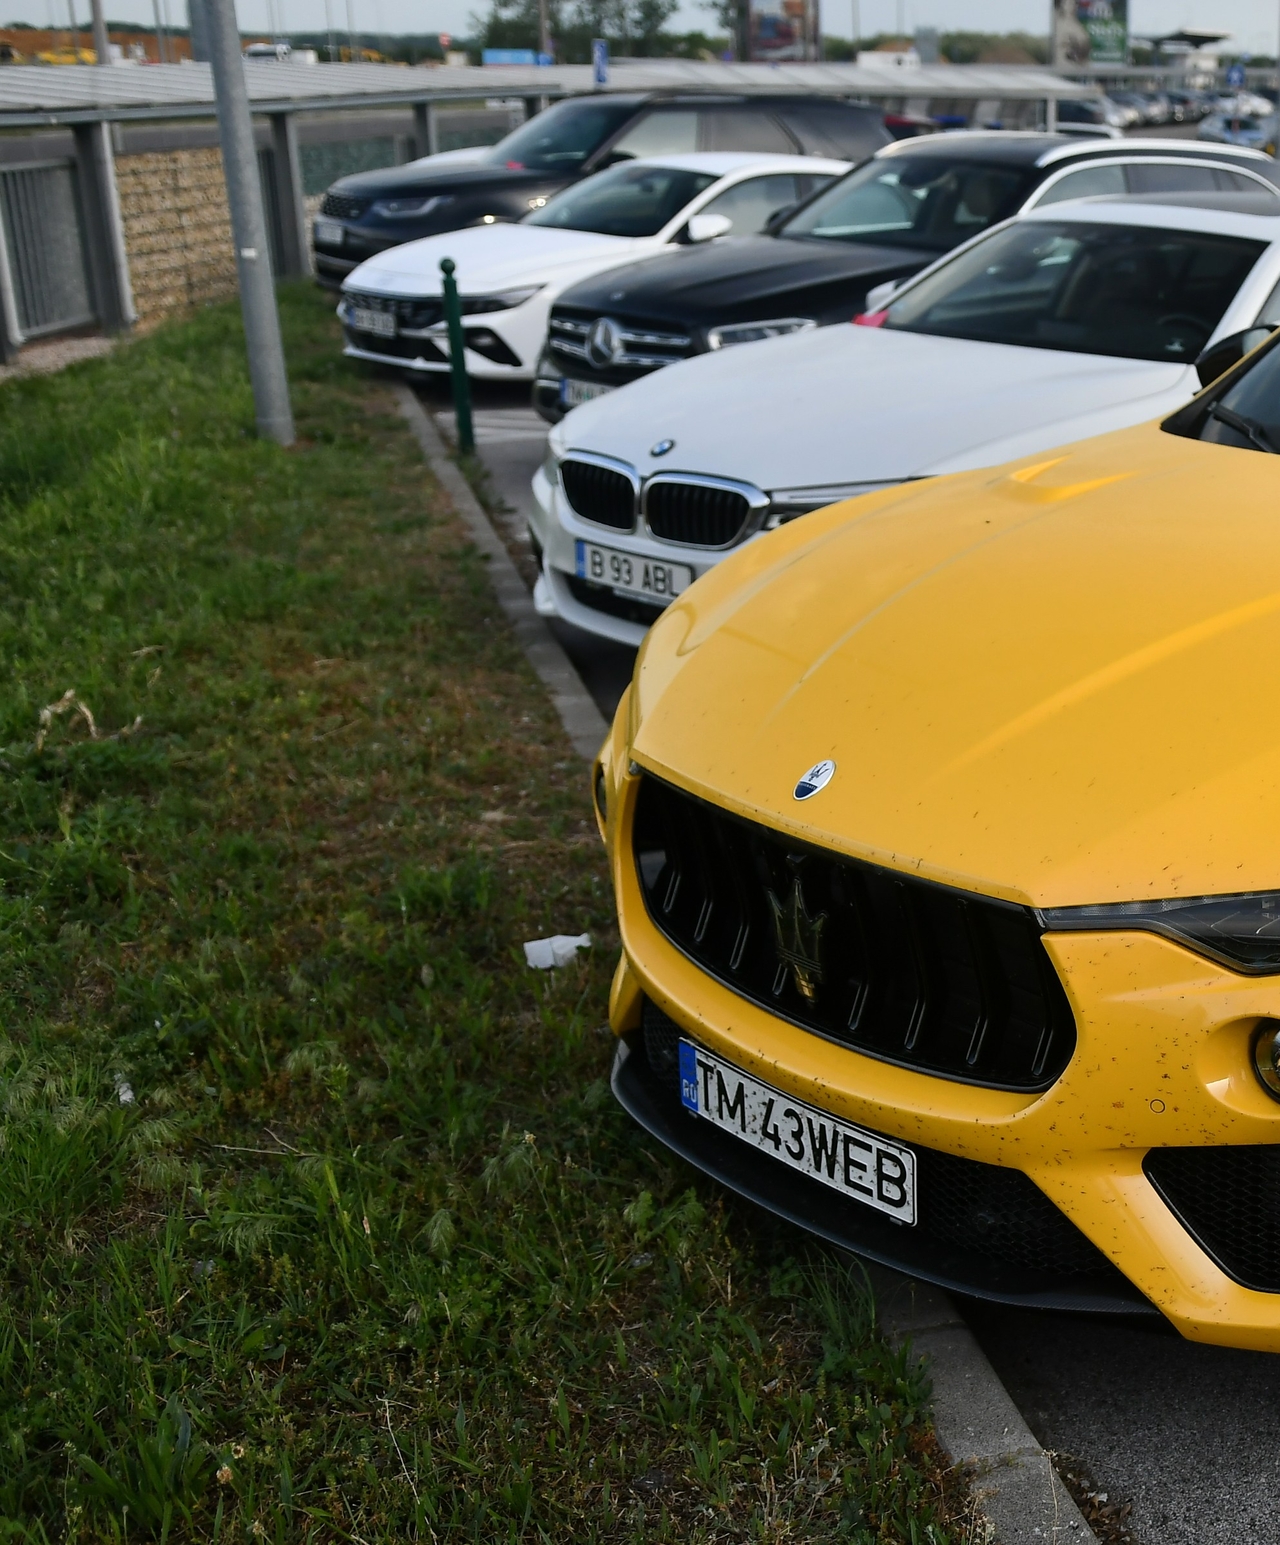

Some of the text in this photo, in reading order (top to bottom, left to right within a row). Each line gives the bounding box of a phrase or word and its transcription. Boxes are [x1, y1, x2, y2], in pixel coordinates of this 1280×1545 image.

[591, 550, 604, 577] B
[610, 555, 632, 585] 93
[683, 1078, 697, 1103] RO
[697, 1057, 747, 1134] TM
